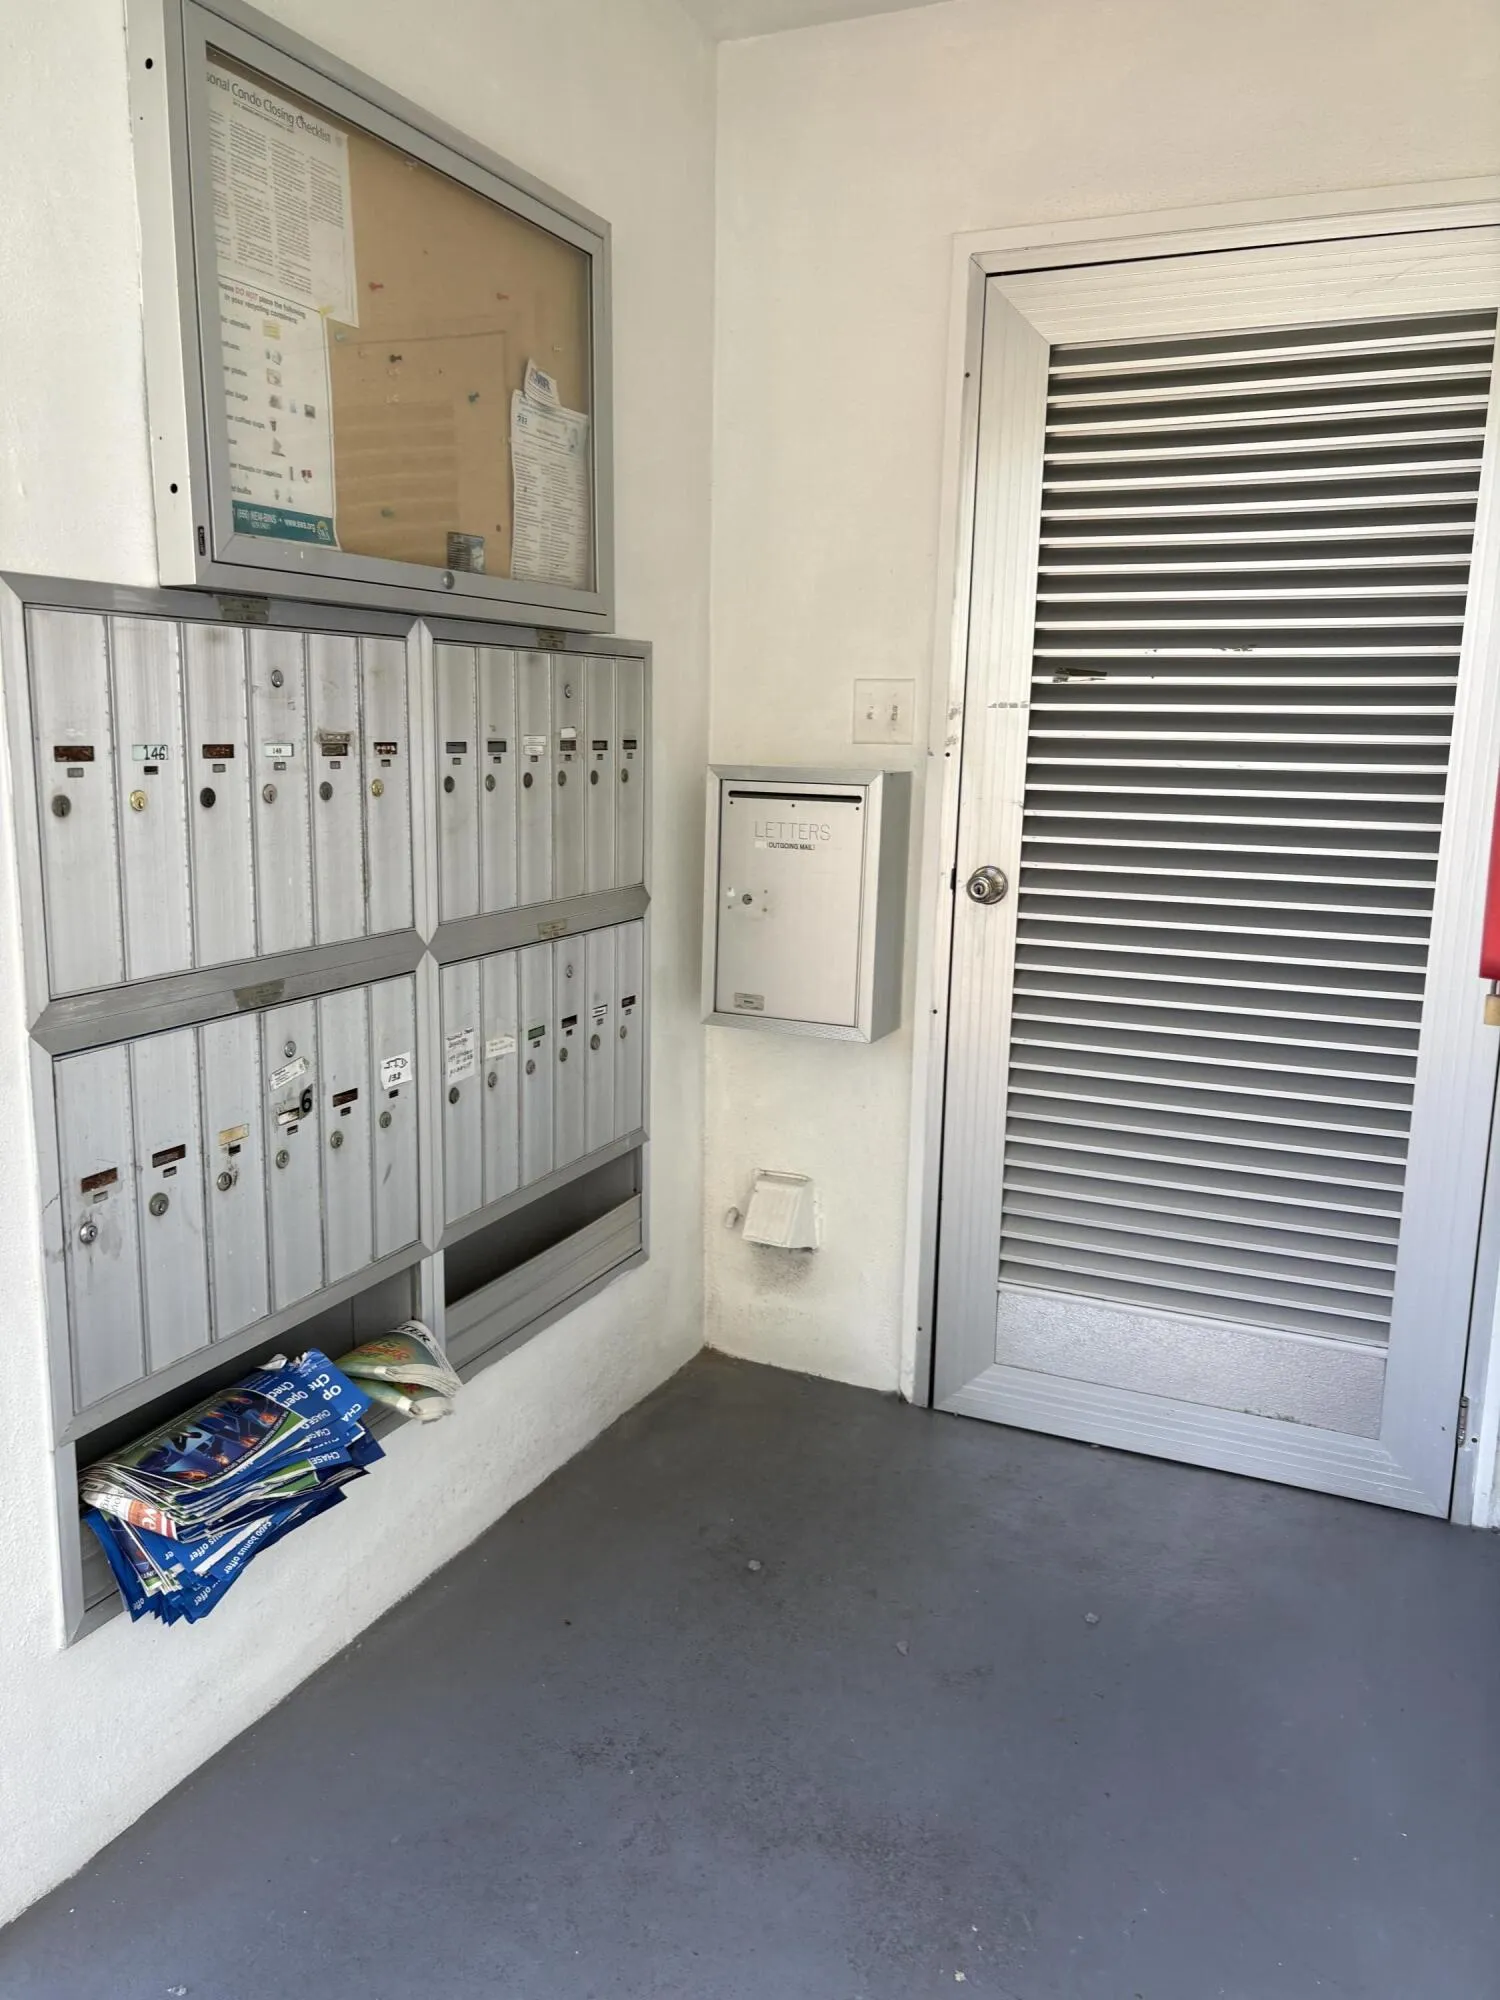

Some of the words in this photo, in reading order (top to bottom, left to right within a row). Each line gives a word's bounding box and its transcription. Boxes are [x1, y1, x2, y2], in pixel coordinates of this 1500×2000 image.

[231, 82, 262, 108] Condo
[263, 99, 295, 129] Closing
[144, 744, 165, 761] 146
[754, 820, 832, 842] LETTERS
[768, 841, 799, 850] OUTGOING
[302, 1087, 313, 1113] 6
[310, 1409, 331, 1425] CHASE
[310, 1451, 340, 1465] CHASE
[189, 1542, 209, 1562] offer
[237, 1535, 260, 1556] bonus
[223, 1556, 241, 1574] offer
[193, 1586, 212, 1606] offer
